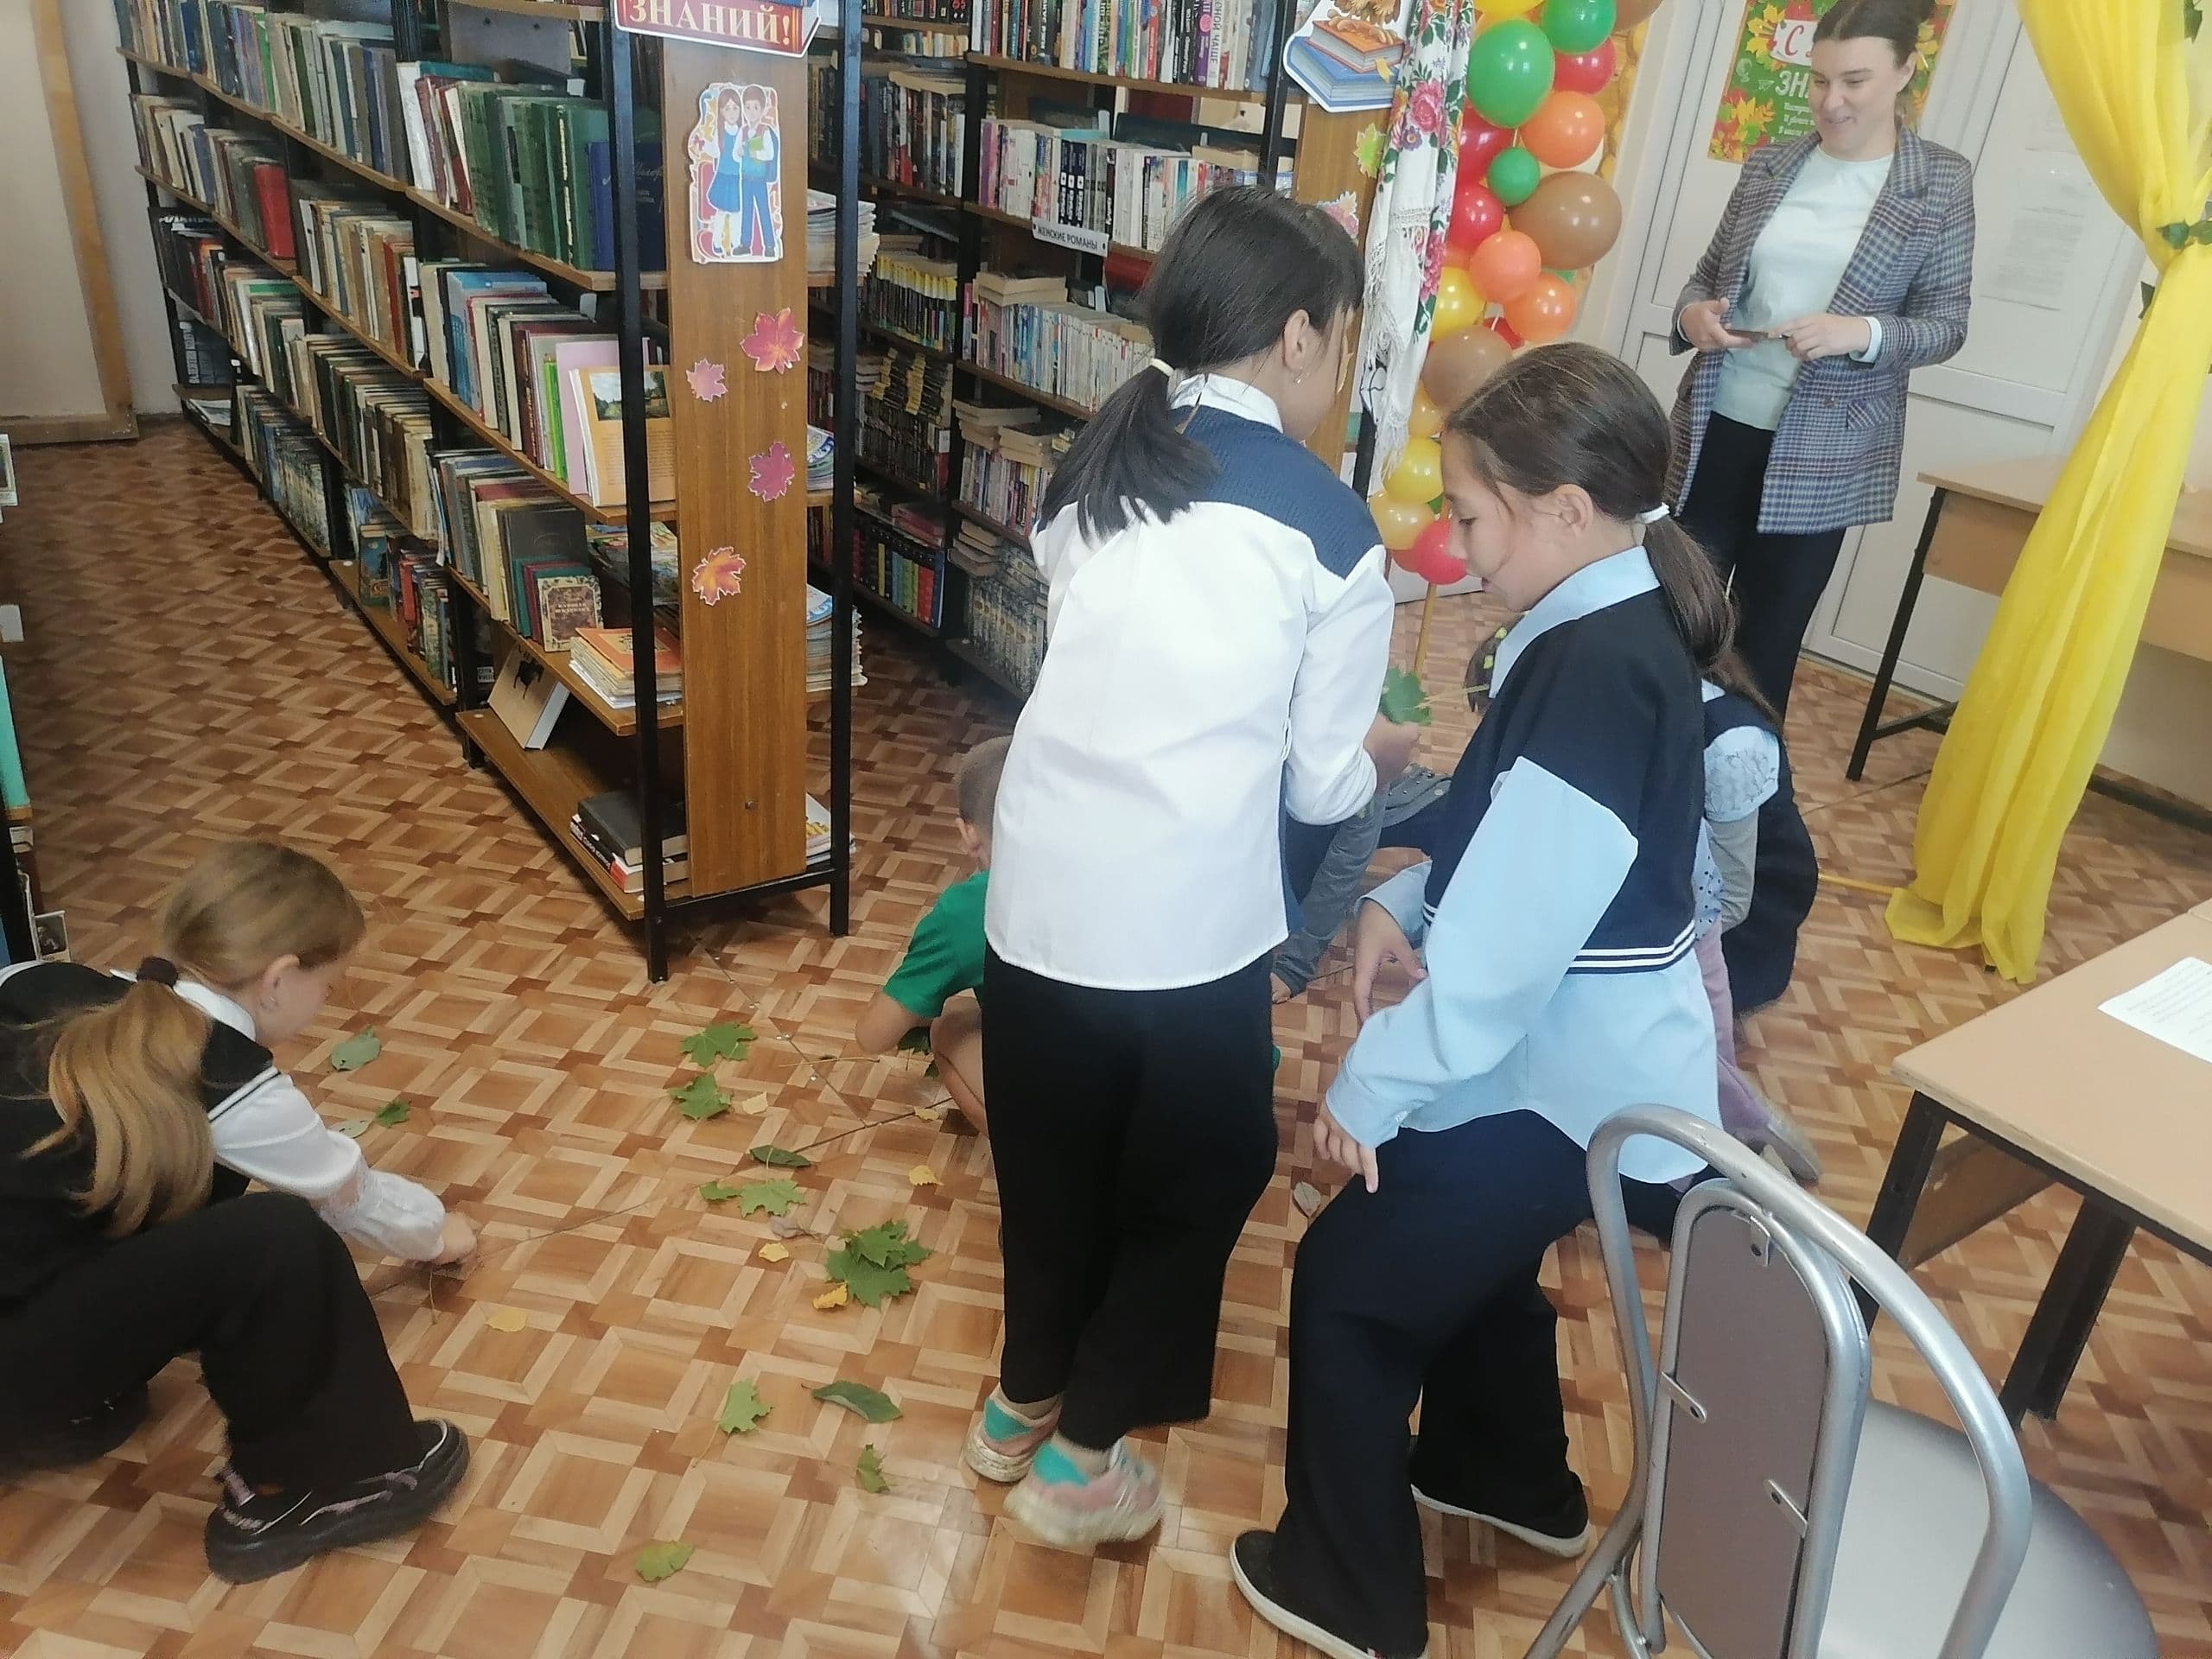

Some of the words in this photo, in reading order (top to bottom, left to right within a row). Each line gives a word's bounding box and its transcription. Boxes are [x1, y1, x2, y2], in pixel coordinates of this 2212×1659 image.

[629, 0, 791, 45] ЗНАНИЙ!
[1784, 24, 1804, 56] С
[1775, 71, 1810, 99] ЗН
[1037, 226, 1065, 242] ЖЕНСКИЕ
[1066, 232, 1098, 251] РОМАНЫ
